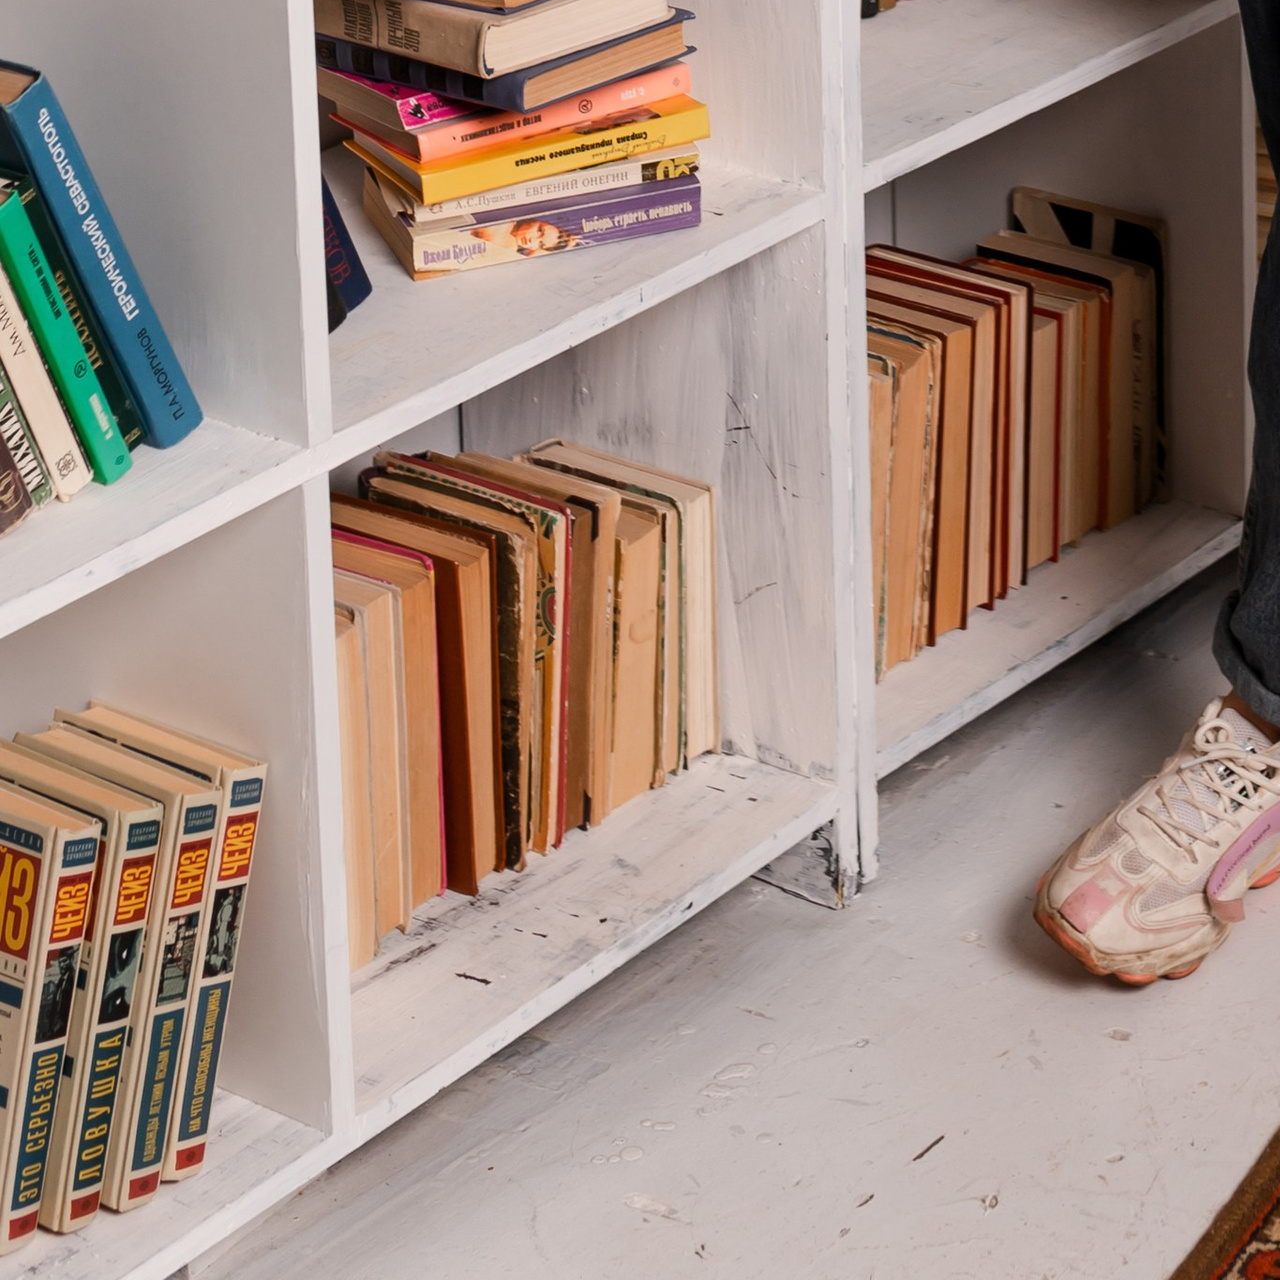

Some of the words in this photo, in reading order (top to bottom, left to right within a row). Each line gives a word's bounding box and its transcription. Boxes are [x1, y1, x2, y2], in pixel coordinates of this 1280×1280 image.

[403, 26, 421, 53] ЗОВ
[37, 106, 91, 216] СЕВАСТОПОЛЬ
[514, 153, 547, 167] месяца
[549, 139, 613, 160] тринадцатого
[616, 131, 648, 145] Страна
[581, 171, 629, 187] ОНЕГИН
[82, 213, 140, 322] ГЕРОИЧЕСКИЙ
[221, 822, 255, 877] ЧЕЙЗ
[116, 864, 152, 921] ЧЕЙЗ
[174, 848, 209, 904] ЧЕЙЗ
[52, 882, 89, 939] ЧЕЙЗ
[25, 1052, 59, 1154] СЕРЬЕЗНО
[78, 1032, 123, 1182] ЛОВУШКА
[188, 1117, 201, 1134] НА
[191, 1095, 205, 1119] ЧТО
[18, 1161, 42, 1203] ЭТО
